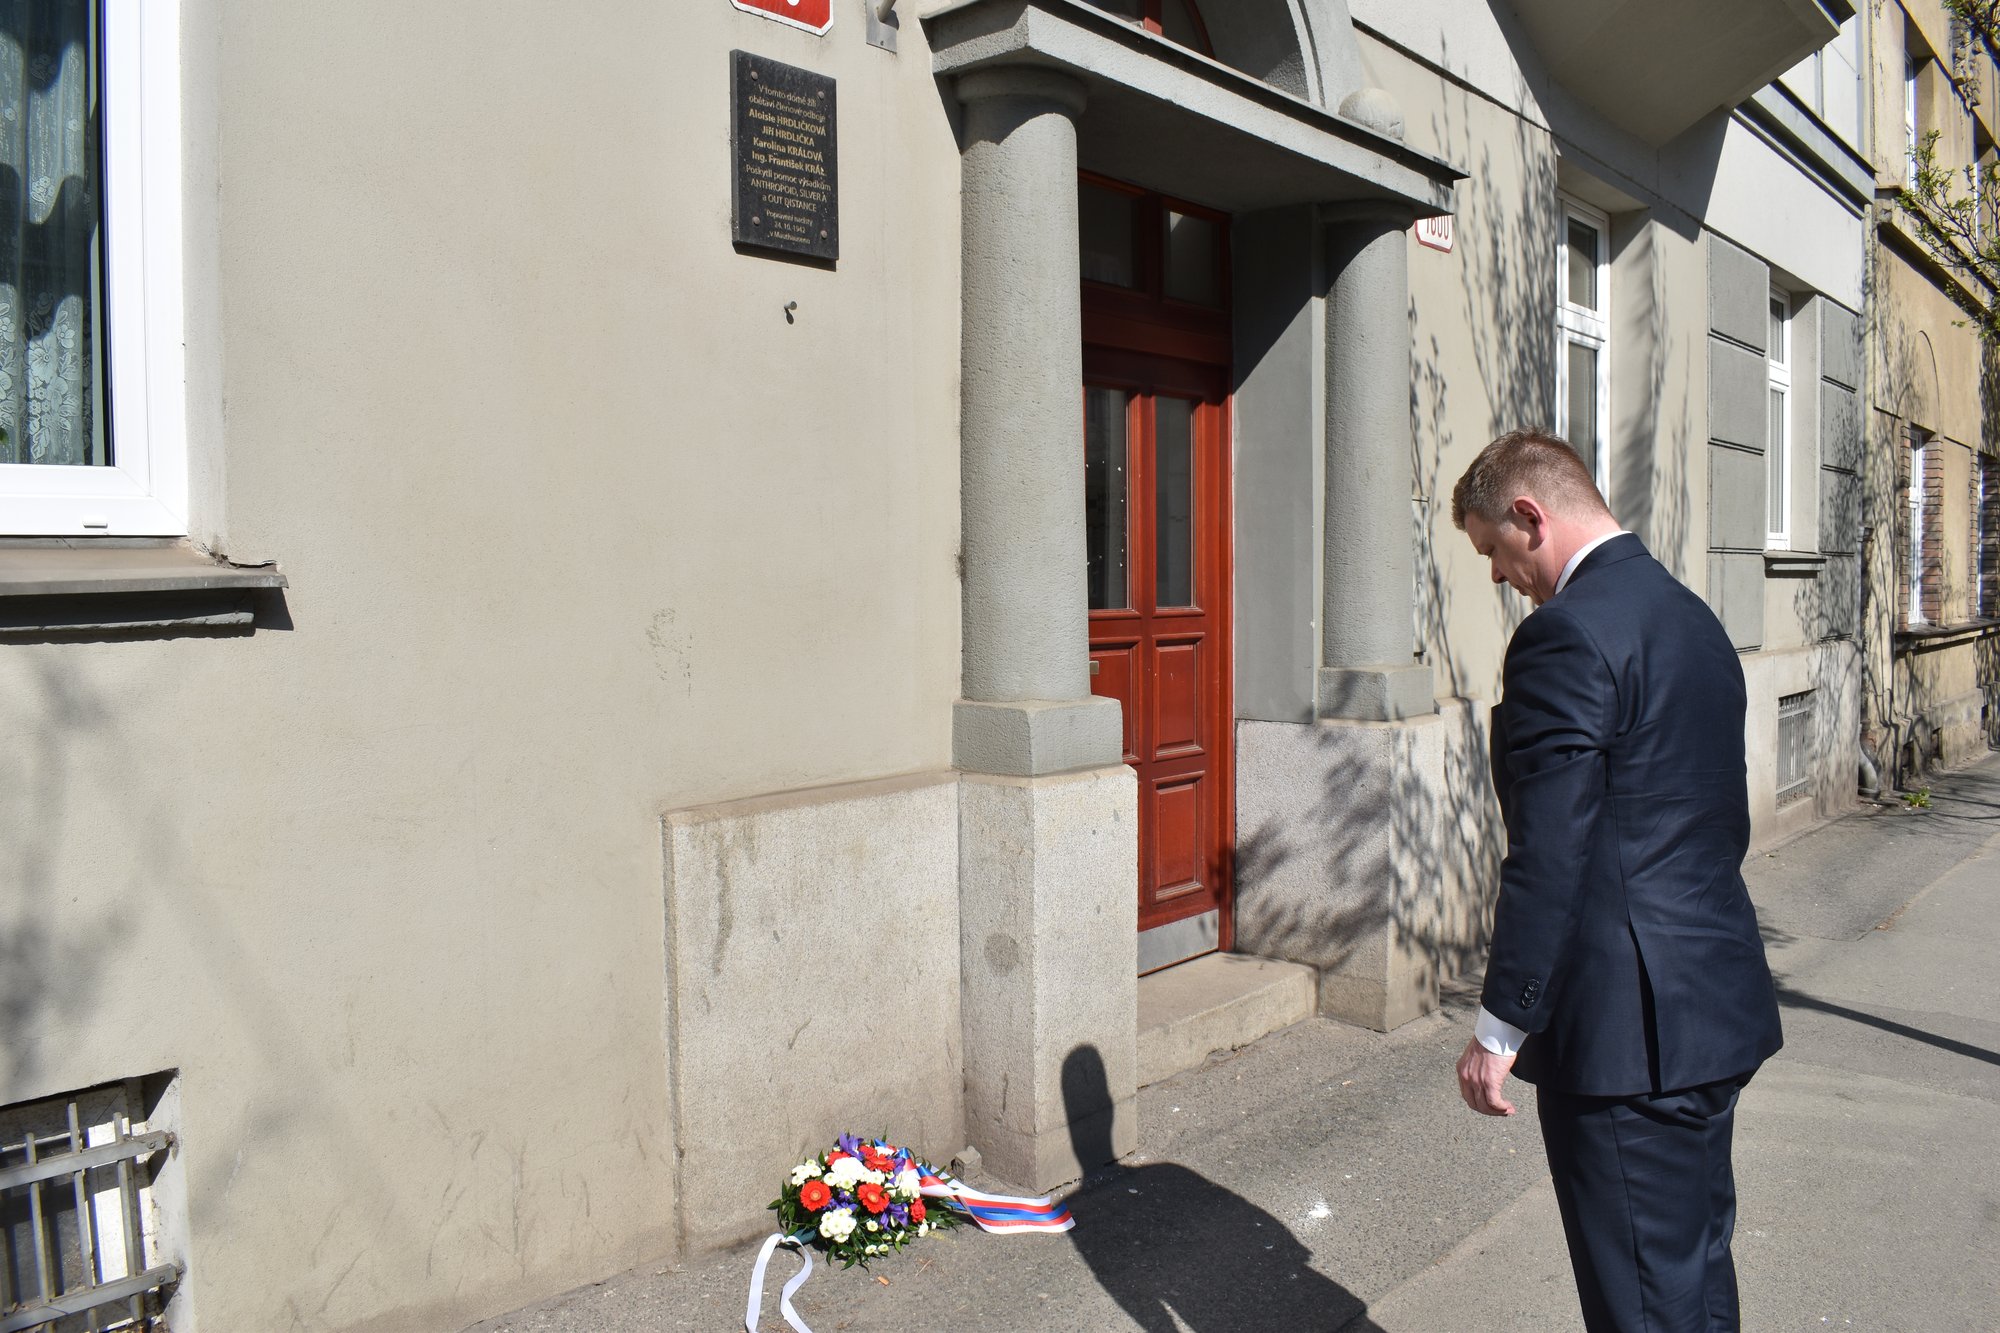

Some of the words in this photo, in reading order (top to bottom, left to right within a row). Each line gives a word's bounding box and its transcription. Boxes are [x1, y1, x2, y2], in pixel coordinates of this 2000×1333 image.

[764, 86, 786, 99] tomto
[787, 92, 806, 104] domě
[807, 97, 816, 108] žili
[749, 108, 776, 123] Aloisie
[777, 116, 826, 136] HRDLIČKOVÁ
[776, 101, 802, 116] členové
[803, 109, 826, 122] odboje
[762, 126, 774, 136] Jiří
[776, 128, 814, 146] HRDLIČKA
[753, 136, 786, 152] Karolina
[788, 145, 824, 162] KRÁLOVÁ
[752, 151, 767, 164] Ing.
[768, 154, 804, 171] František
[805, 163, 826, 176] KRÁL
[746, 164, 772, 178] Poskytli
[774, 172, 797, 184] pomoc
[798, 177, 831, 192] výsadkům
[751, 178, 798, 198] ANTHROPOID,
[800, 189, 821, 201] SILVER
[822, 194, 827, 204] A
[768, 194, 782, 205] OUT
[784, 198, 816, 212] DISTANCE
